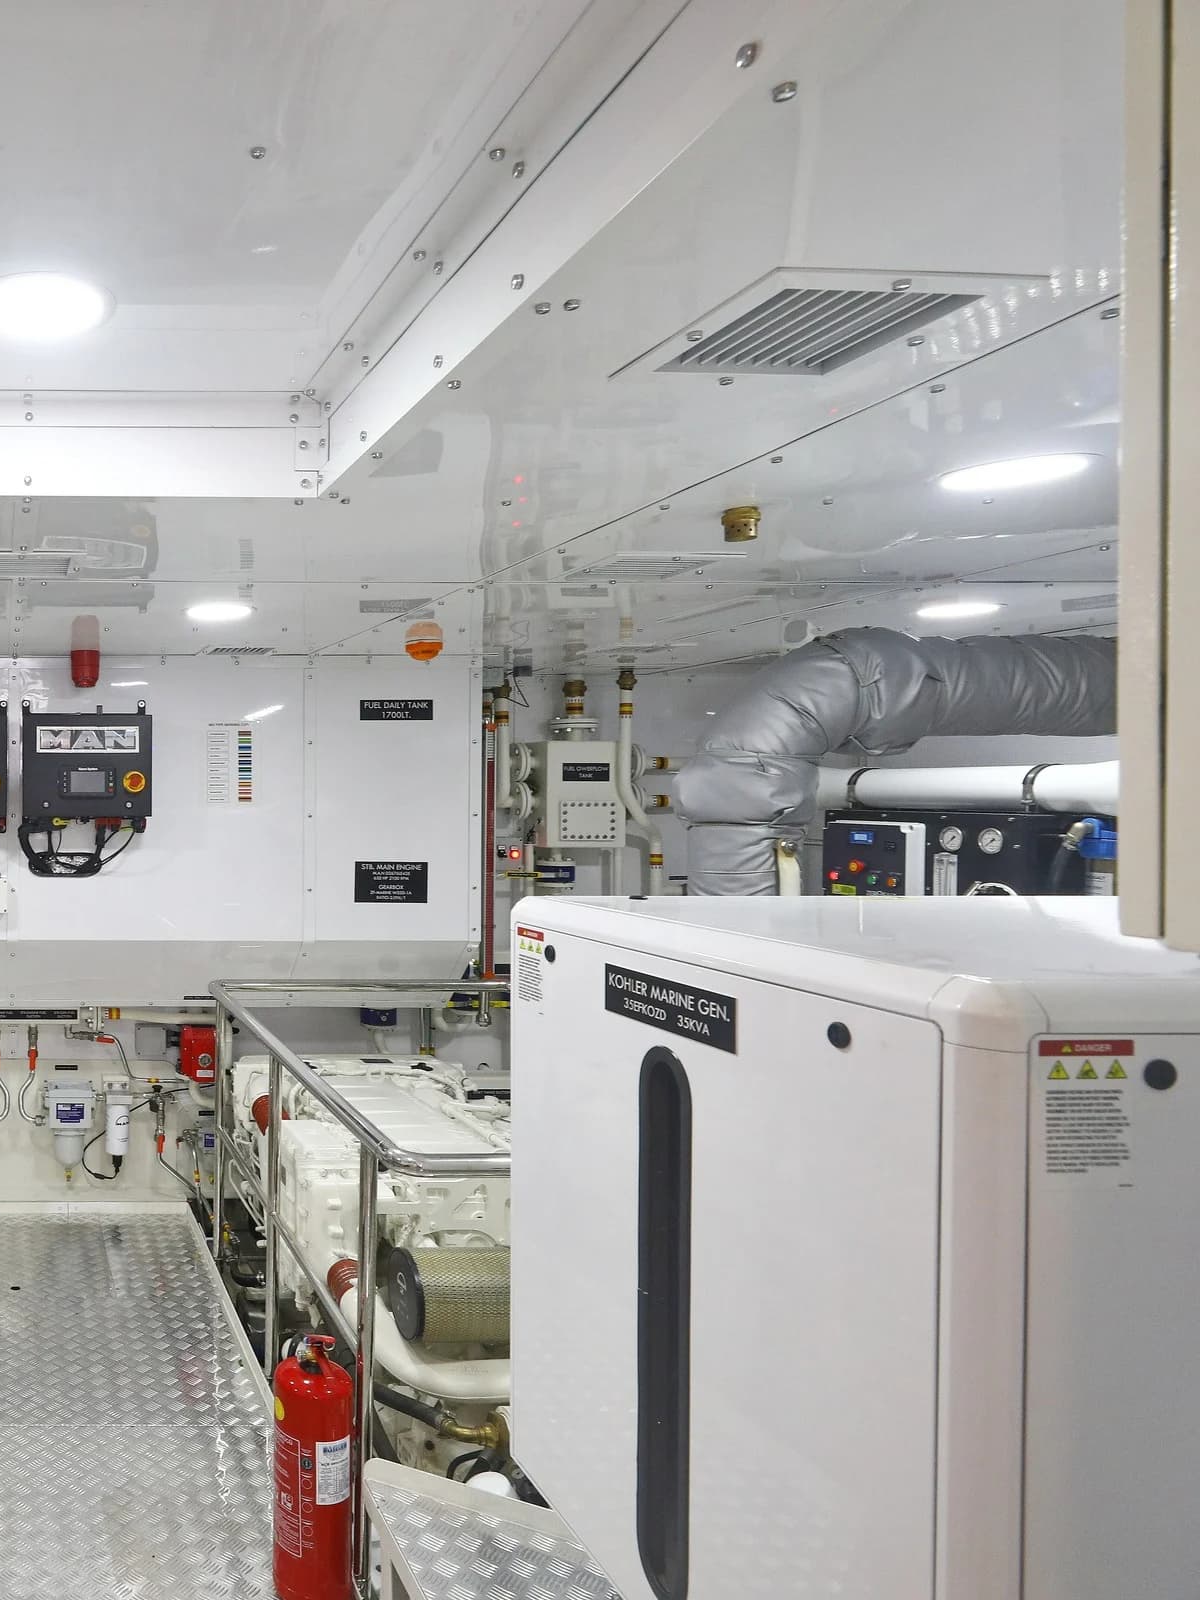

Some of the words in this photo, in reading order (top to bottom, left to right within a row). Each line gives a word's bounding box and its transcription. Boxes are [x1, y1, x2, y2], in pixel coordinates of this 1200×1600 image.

[364, 701, 382, 709] FUEL
[383, 701, 405, 709] DAILY
[407, 701, 429, 709] TANK
[41, 729, 136, 749] MAN
[396, 863, 423, 871] ENGINE
[608, 972, 647, 997] KOHLER
[650, 985, 695, 1012] MARINE
[697, 999, 730, 1022] GEN.
[623, 997, 667, 1021] 35EFKOZD
[676, 1014, 710, 1037] 35KVA
[1074, 1044, 1112, 1052] DANGER
